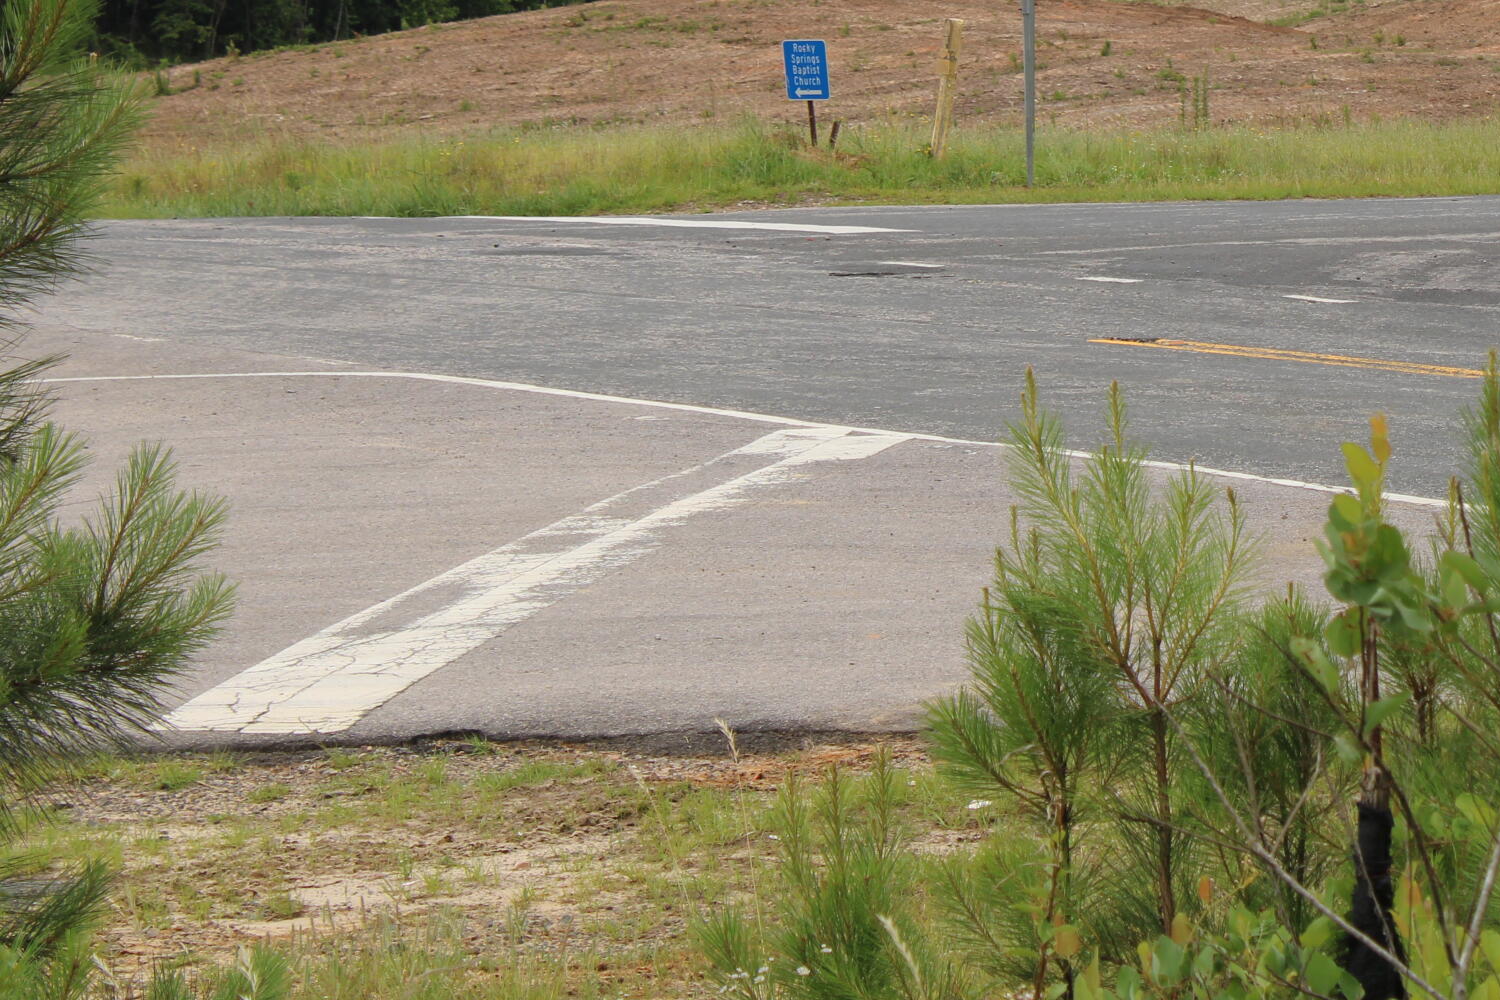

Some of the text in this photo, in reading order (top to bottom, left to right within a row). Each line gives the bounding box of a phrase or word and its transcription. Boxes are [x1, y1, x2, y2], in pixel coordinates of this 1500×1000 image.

[792, 43, 816, 54] Rocky
[791, 54, 821, 65] Springs
[792, 65, 820, 75] Baptist
[793, 75, 821, 86] Church
